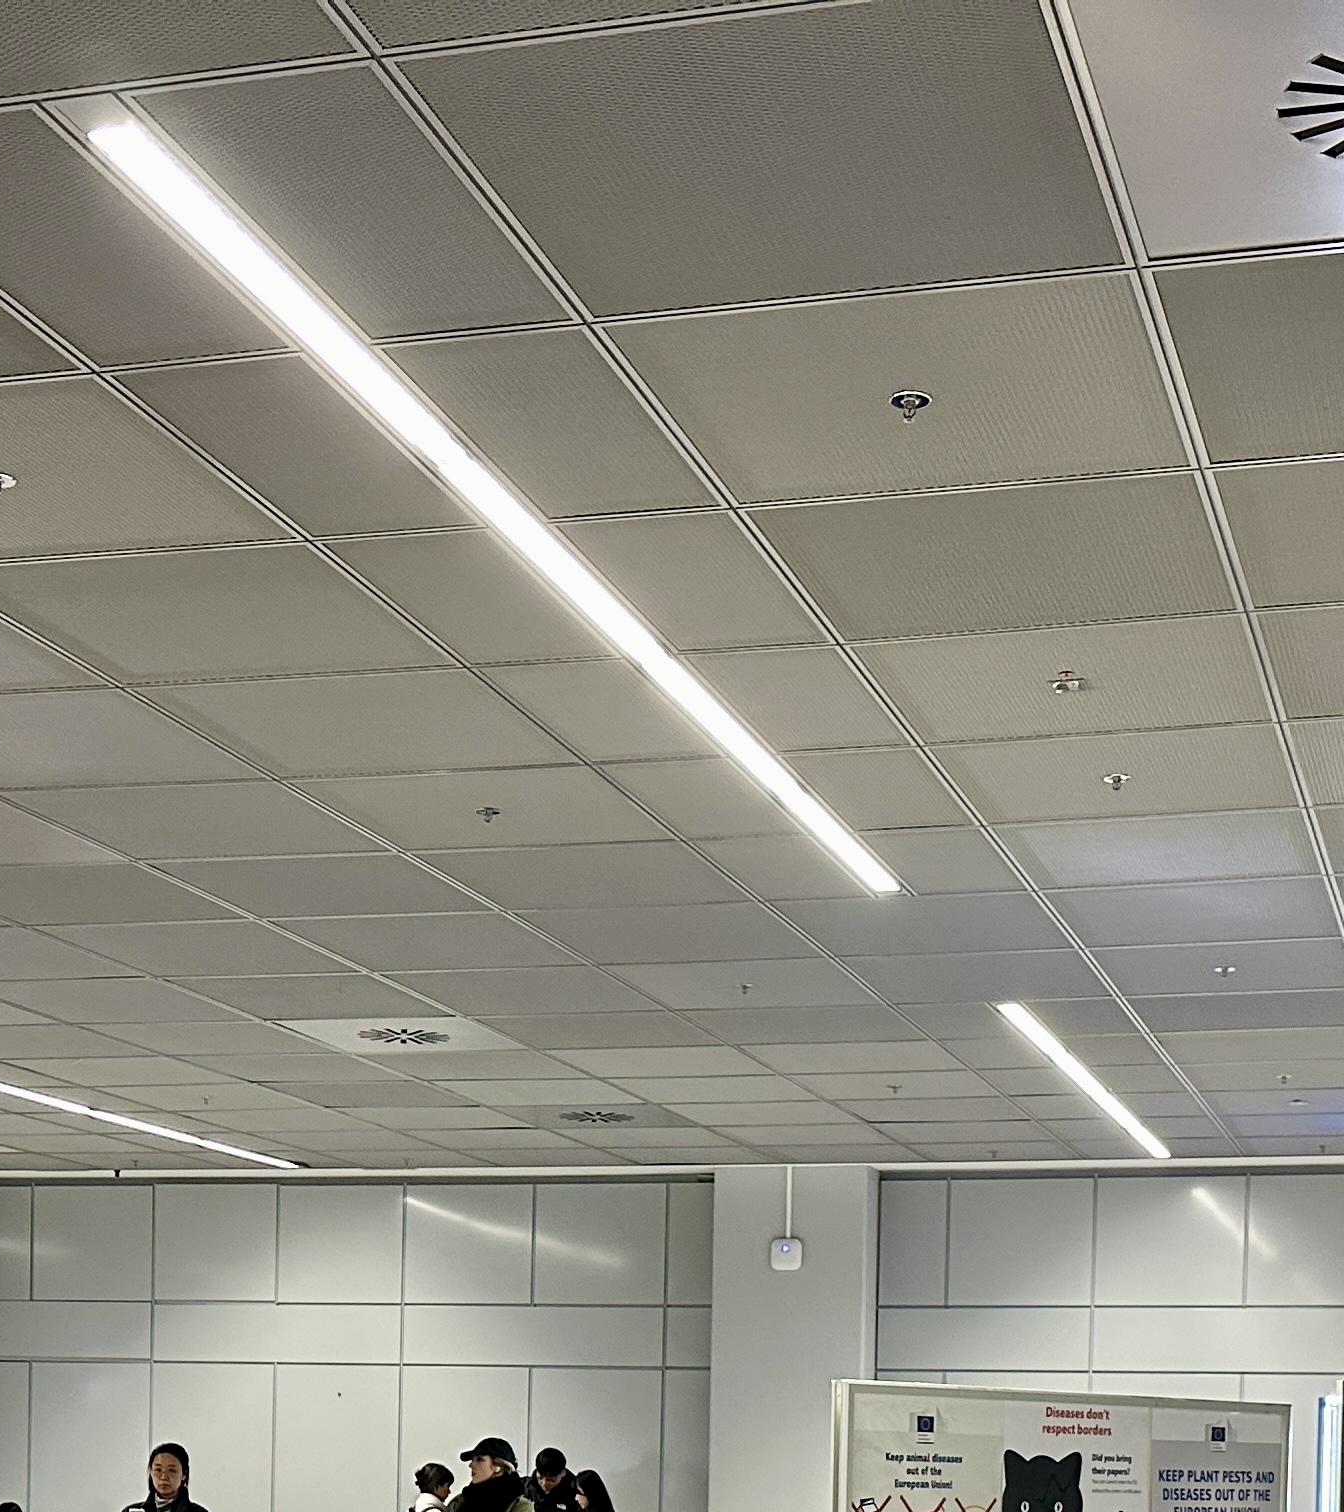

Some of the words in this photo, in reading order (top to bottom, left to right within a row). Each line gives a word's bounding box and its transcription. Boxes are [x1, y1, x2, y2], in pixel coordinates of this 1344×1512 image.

[1046, 1406, 1085, 1419] Diseases
[1086, 1408, 1110, 1420] don't
[1042, 1424, 1076, 1437] respect
[1077, 1424, 1112, 1436] borders
[885, 1452, 904, 1464] Keep
[906, 1453, 930, 1462] animal
[932, 1453, 963, 1463] diseases
[1092, 1454, 1103, 1462] Did
[1104, 1455, 1115, 1463] you
[1116, 1454, 1132, 1464] bring
[906, 1467, 919, 1475] out
[921, 1466, 929, 1475] of
[930, 1467, 942, 1475] the
[1092, 1467, 1107, 1475] their
[1107, 1467, 1131, 1476] papers?
[1158, 1469, 1185, 1482] KEEP
[1187, 1470, 1220, 1483] PLANT
[1222, 1470, 1252, 1483] PESTS
[1254, 1471, 1275, 1484] AND
[894, 1479, 929, 1490] European
[1162, 1488, 1212, 1501] DISEASES
[1215, 1488, 1235, 1501] OUT
[1237, 1489, 1251, 1501] OF
[1253, 1489, 1271, 1502] THE
